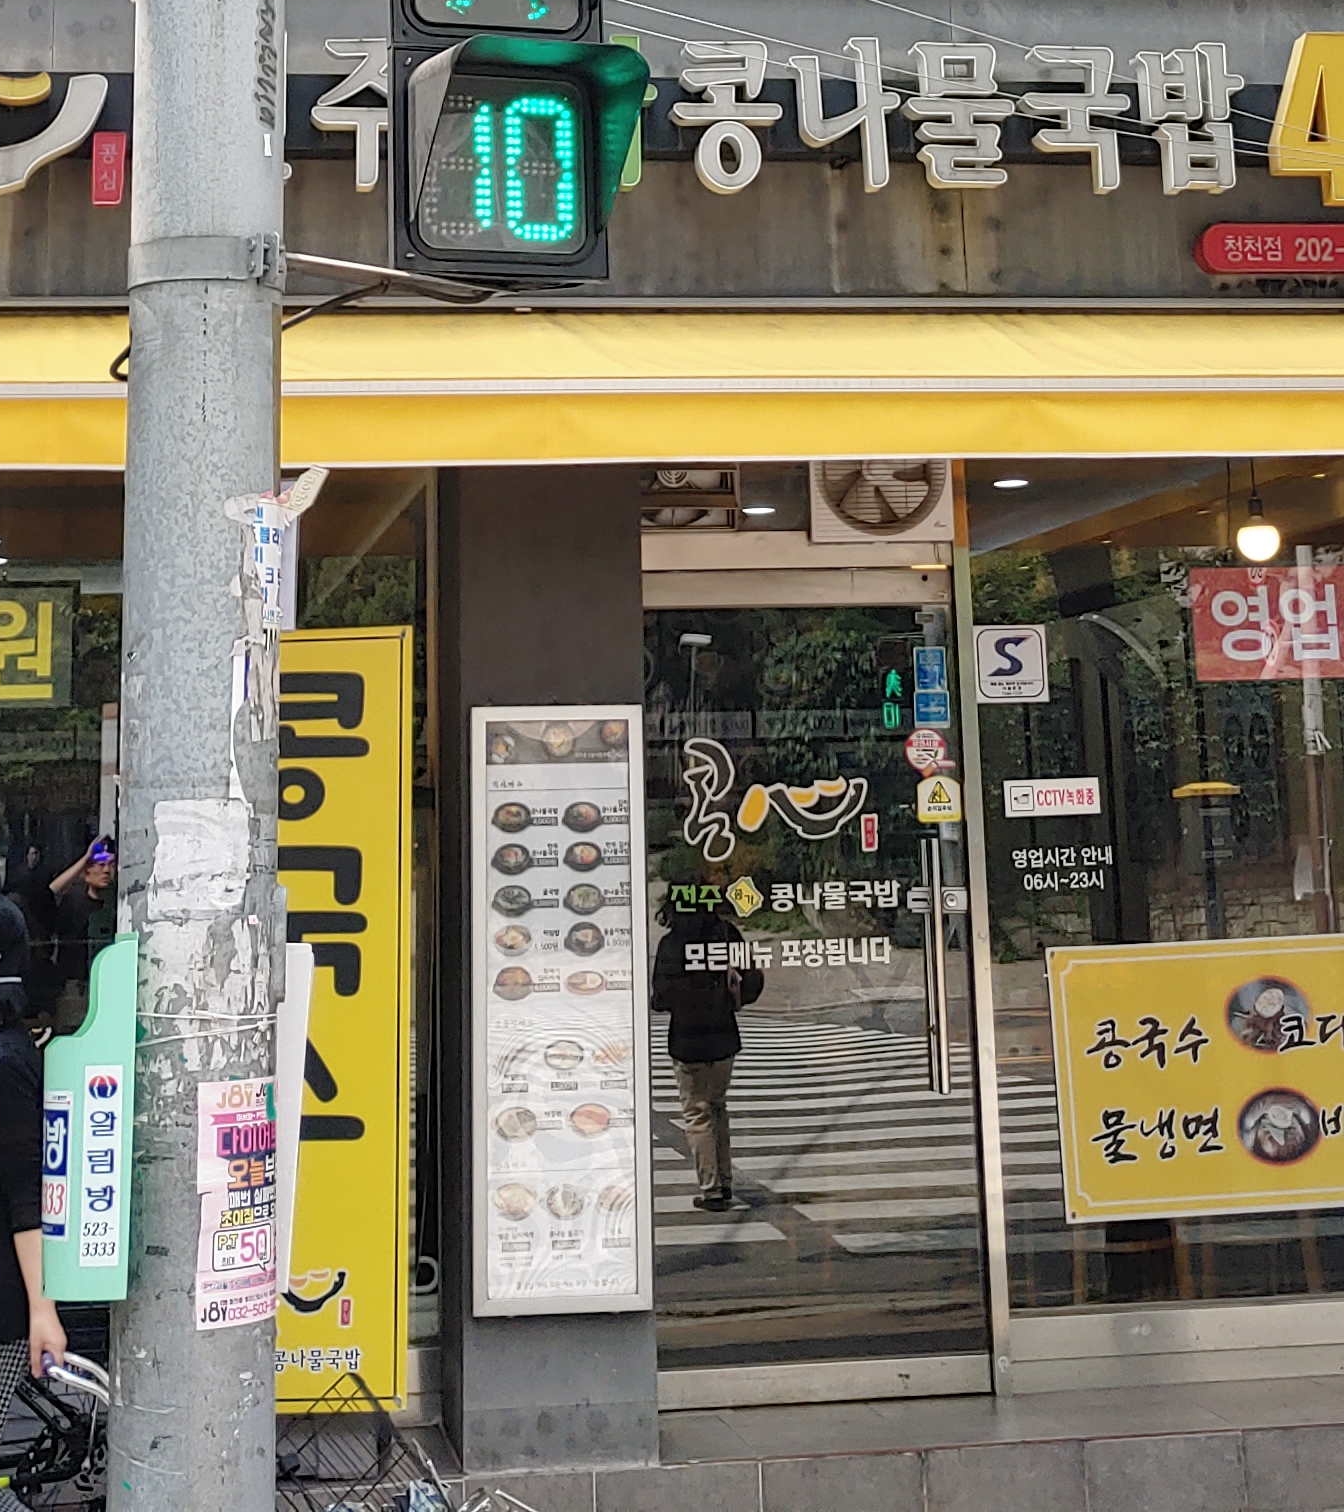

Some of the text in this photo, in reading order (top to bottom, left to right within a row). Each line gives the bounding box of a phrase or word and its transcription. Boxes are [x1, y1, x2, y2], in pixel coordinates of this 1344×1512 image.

[669, 39, 1244, 197] 콩나물국밥
[473, 97, 574, 242] 10
[1223, 234, 1283, 263] 청천점
[1036, 787, 1096, 807] CCTV녹화중
[1011, 845, 1113, 869] 영업시간 안내
[670, 883, 722, 913] 전주
[770, 879, 901, 913] 콩나물국밥
[1023, 869, 1105, 891] 06시~23시
[684, 935, 893, 972] 모든메뉴 포장됩니다
[1084, 1015, 1212, 1070] 콩국수
[1089, 1105, 1227, 1166] 물냉면
[86, 1109, 117, 1213] 알림방
[81, 1241, 117, 1258] 3333
[274, 1348, 361, 1372] 콩나물국밥
